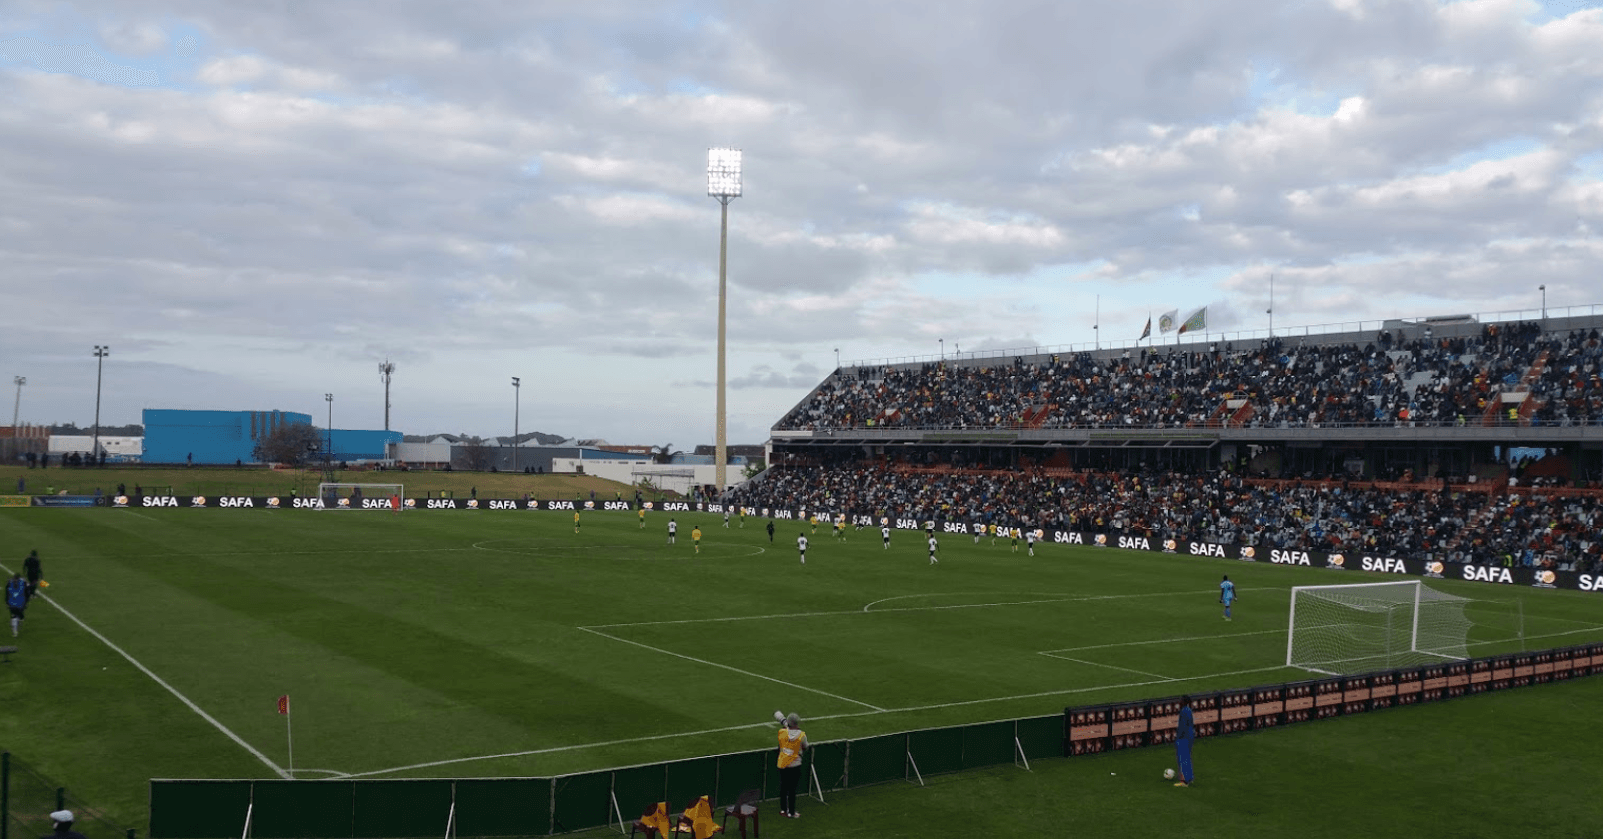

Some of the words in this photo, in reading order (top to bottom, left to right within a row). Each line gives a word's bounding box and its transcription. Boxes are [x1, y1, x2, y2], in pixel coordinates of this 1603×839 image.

[143, 496, 178, 507] SAFA
[220, 497, 253, 508] SAFA
[293, 498, 325, 508] SAFA
[362, 499, 391, 509] SAFA
[427, 499, 455, 509] SAFA
[490, 500, 516, 510] SAFA
[549, 501, 574, 510] SAFA
[604, 501, 628, 510] SAFA
[664, 502, 689, 511] SAFA
[708, 504, 723, 513] SAFA
[741, 506, 756, 517] AFA
[775, 509, 791, 519] SAFA
[896, 518, 918, 530] SAFA
[944, 521, 967, 534] SAFA
[997, 526, 1022, 539] SAA
[1055, 530, 1082, 544] SAFA
[1119, 536, 1150, 550] SAFA
[1190, 542, 1225, 557] SAFA
[1271, 550, 1310, 566] SAFA
[1362, 557, 1406, 573] SAFA
[1464, 566, 1513, 584] SAFA
